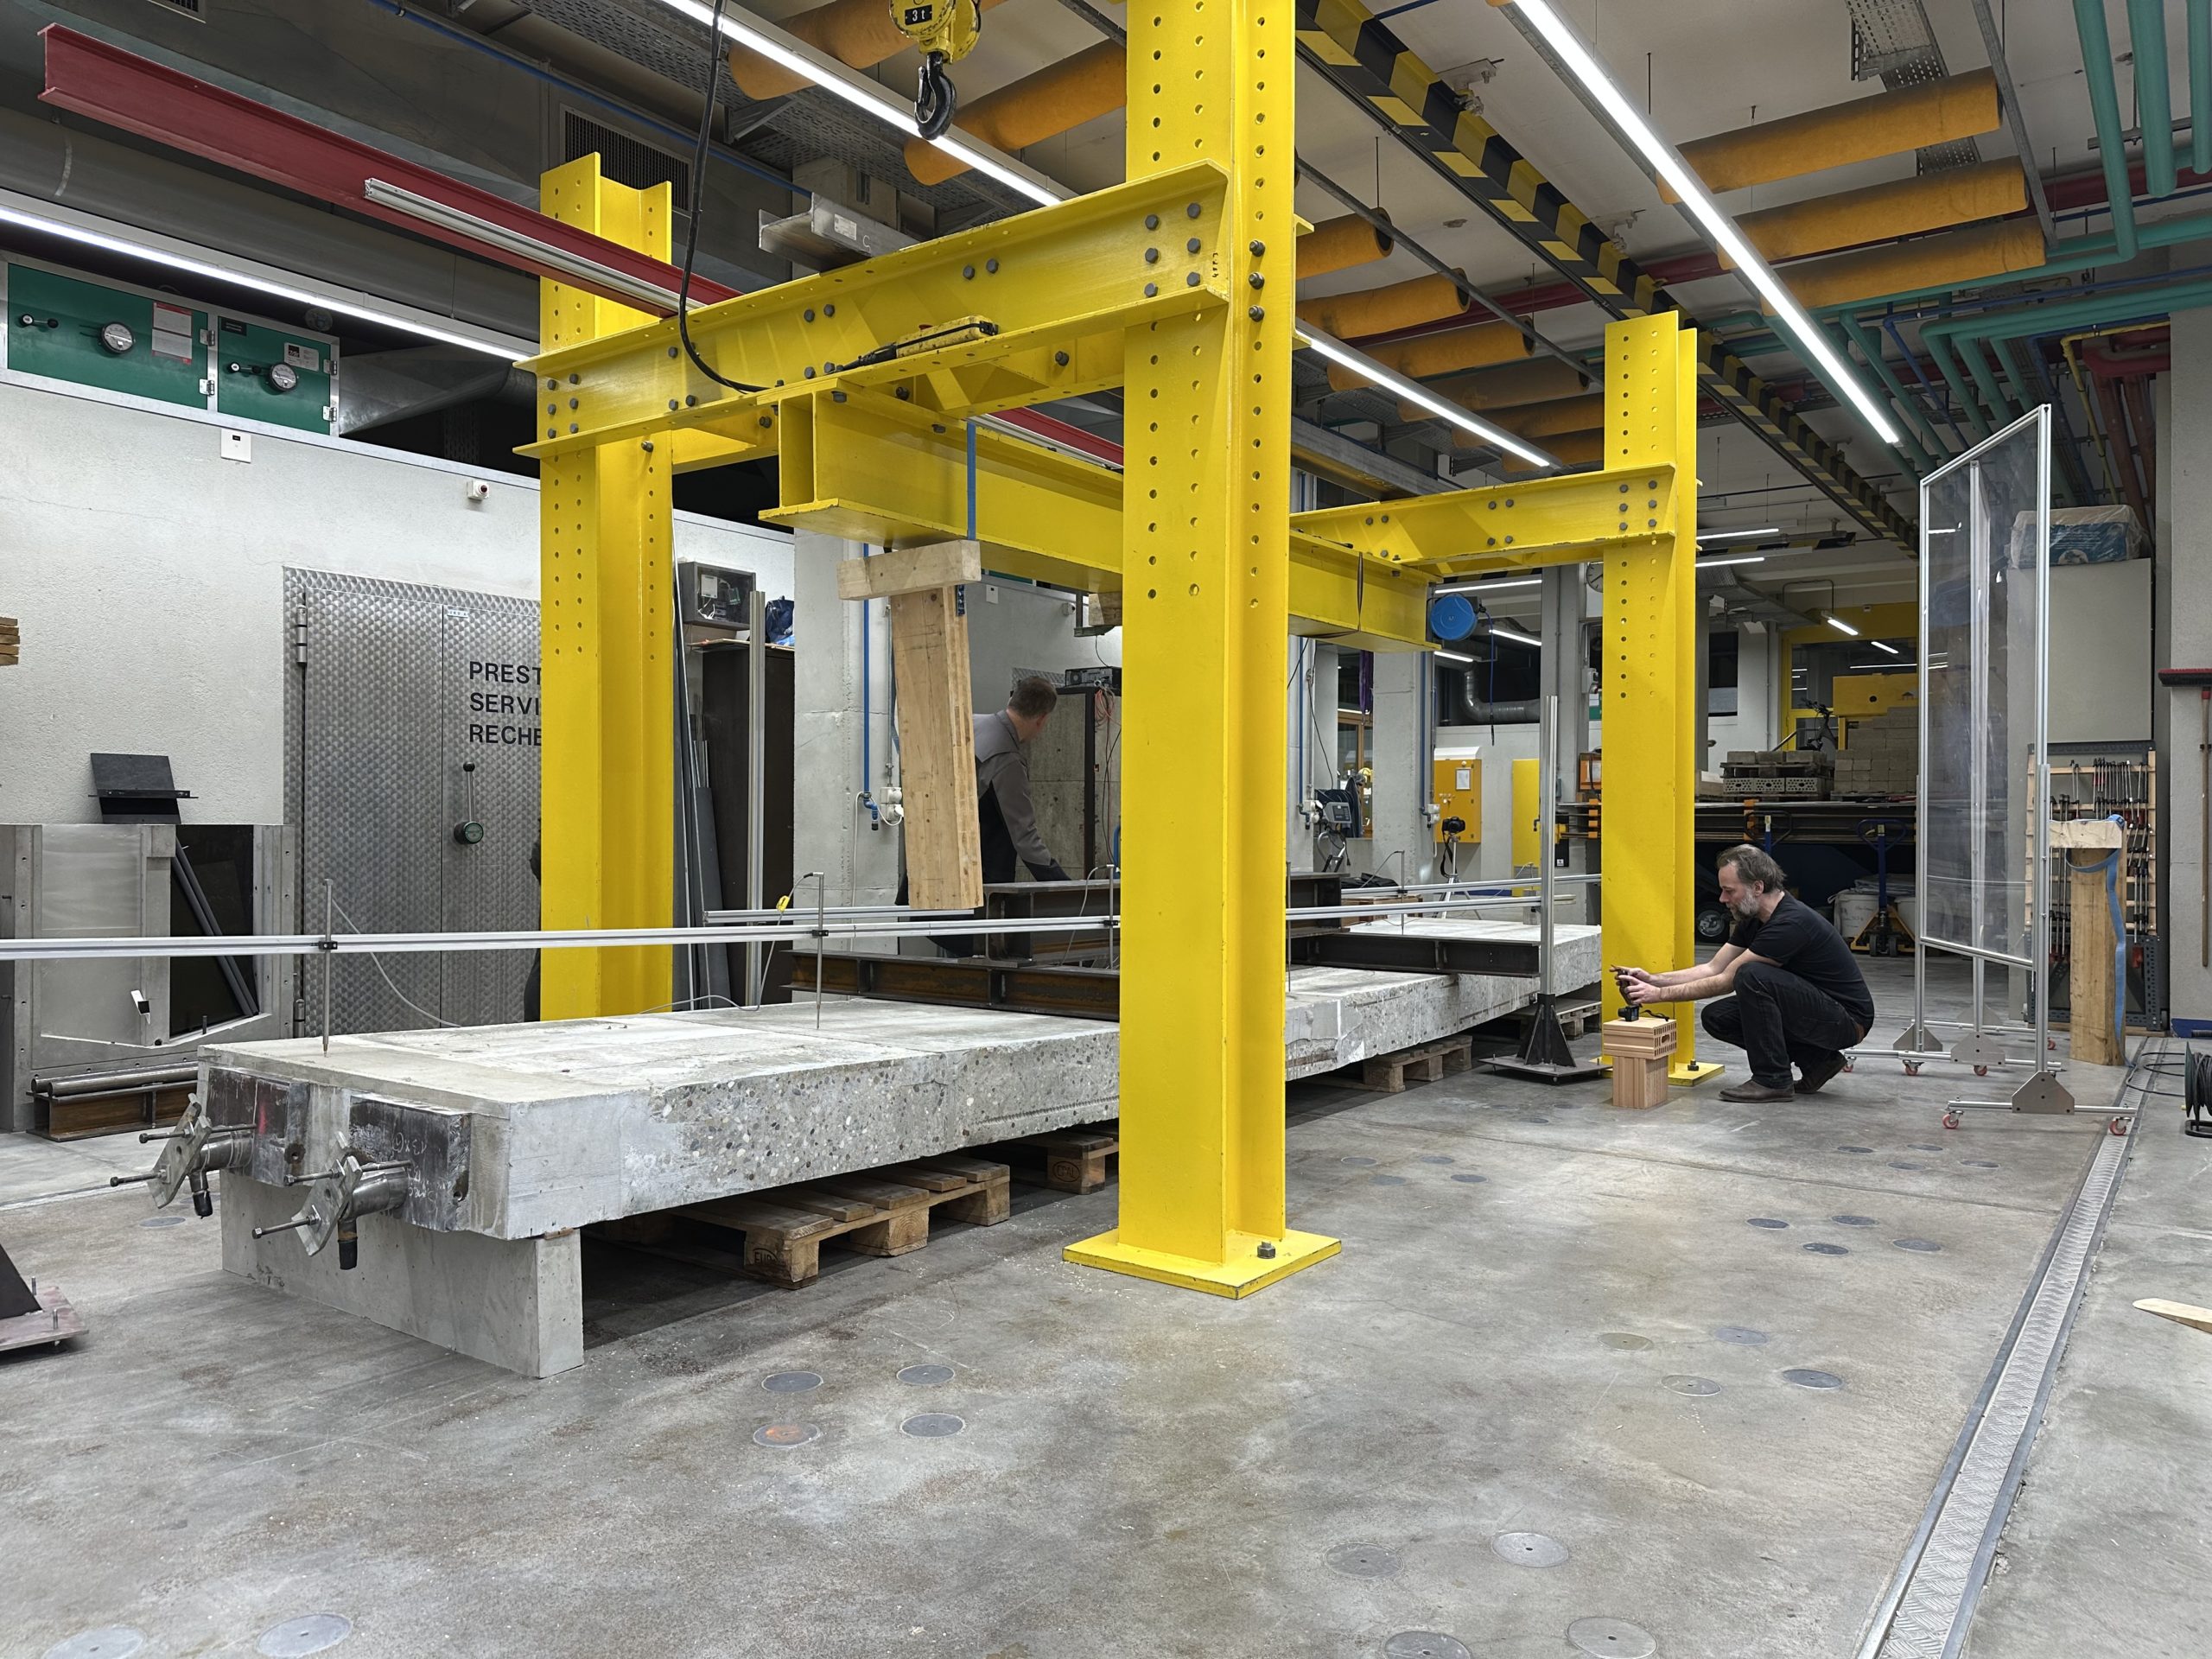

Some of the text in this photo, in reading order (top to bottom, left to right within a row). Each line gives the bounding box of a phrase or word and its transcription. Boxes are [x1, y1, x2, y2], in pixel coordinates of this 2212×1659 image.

[912, 9, 925, 22] 3 t
[469, 661, 542, 685] PREST
[469, 692, 540, 715] SERVI
[469, 724, 542, 747] RECHE
